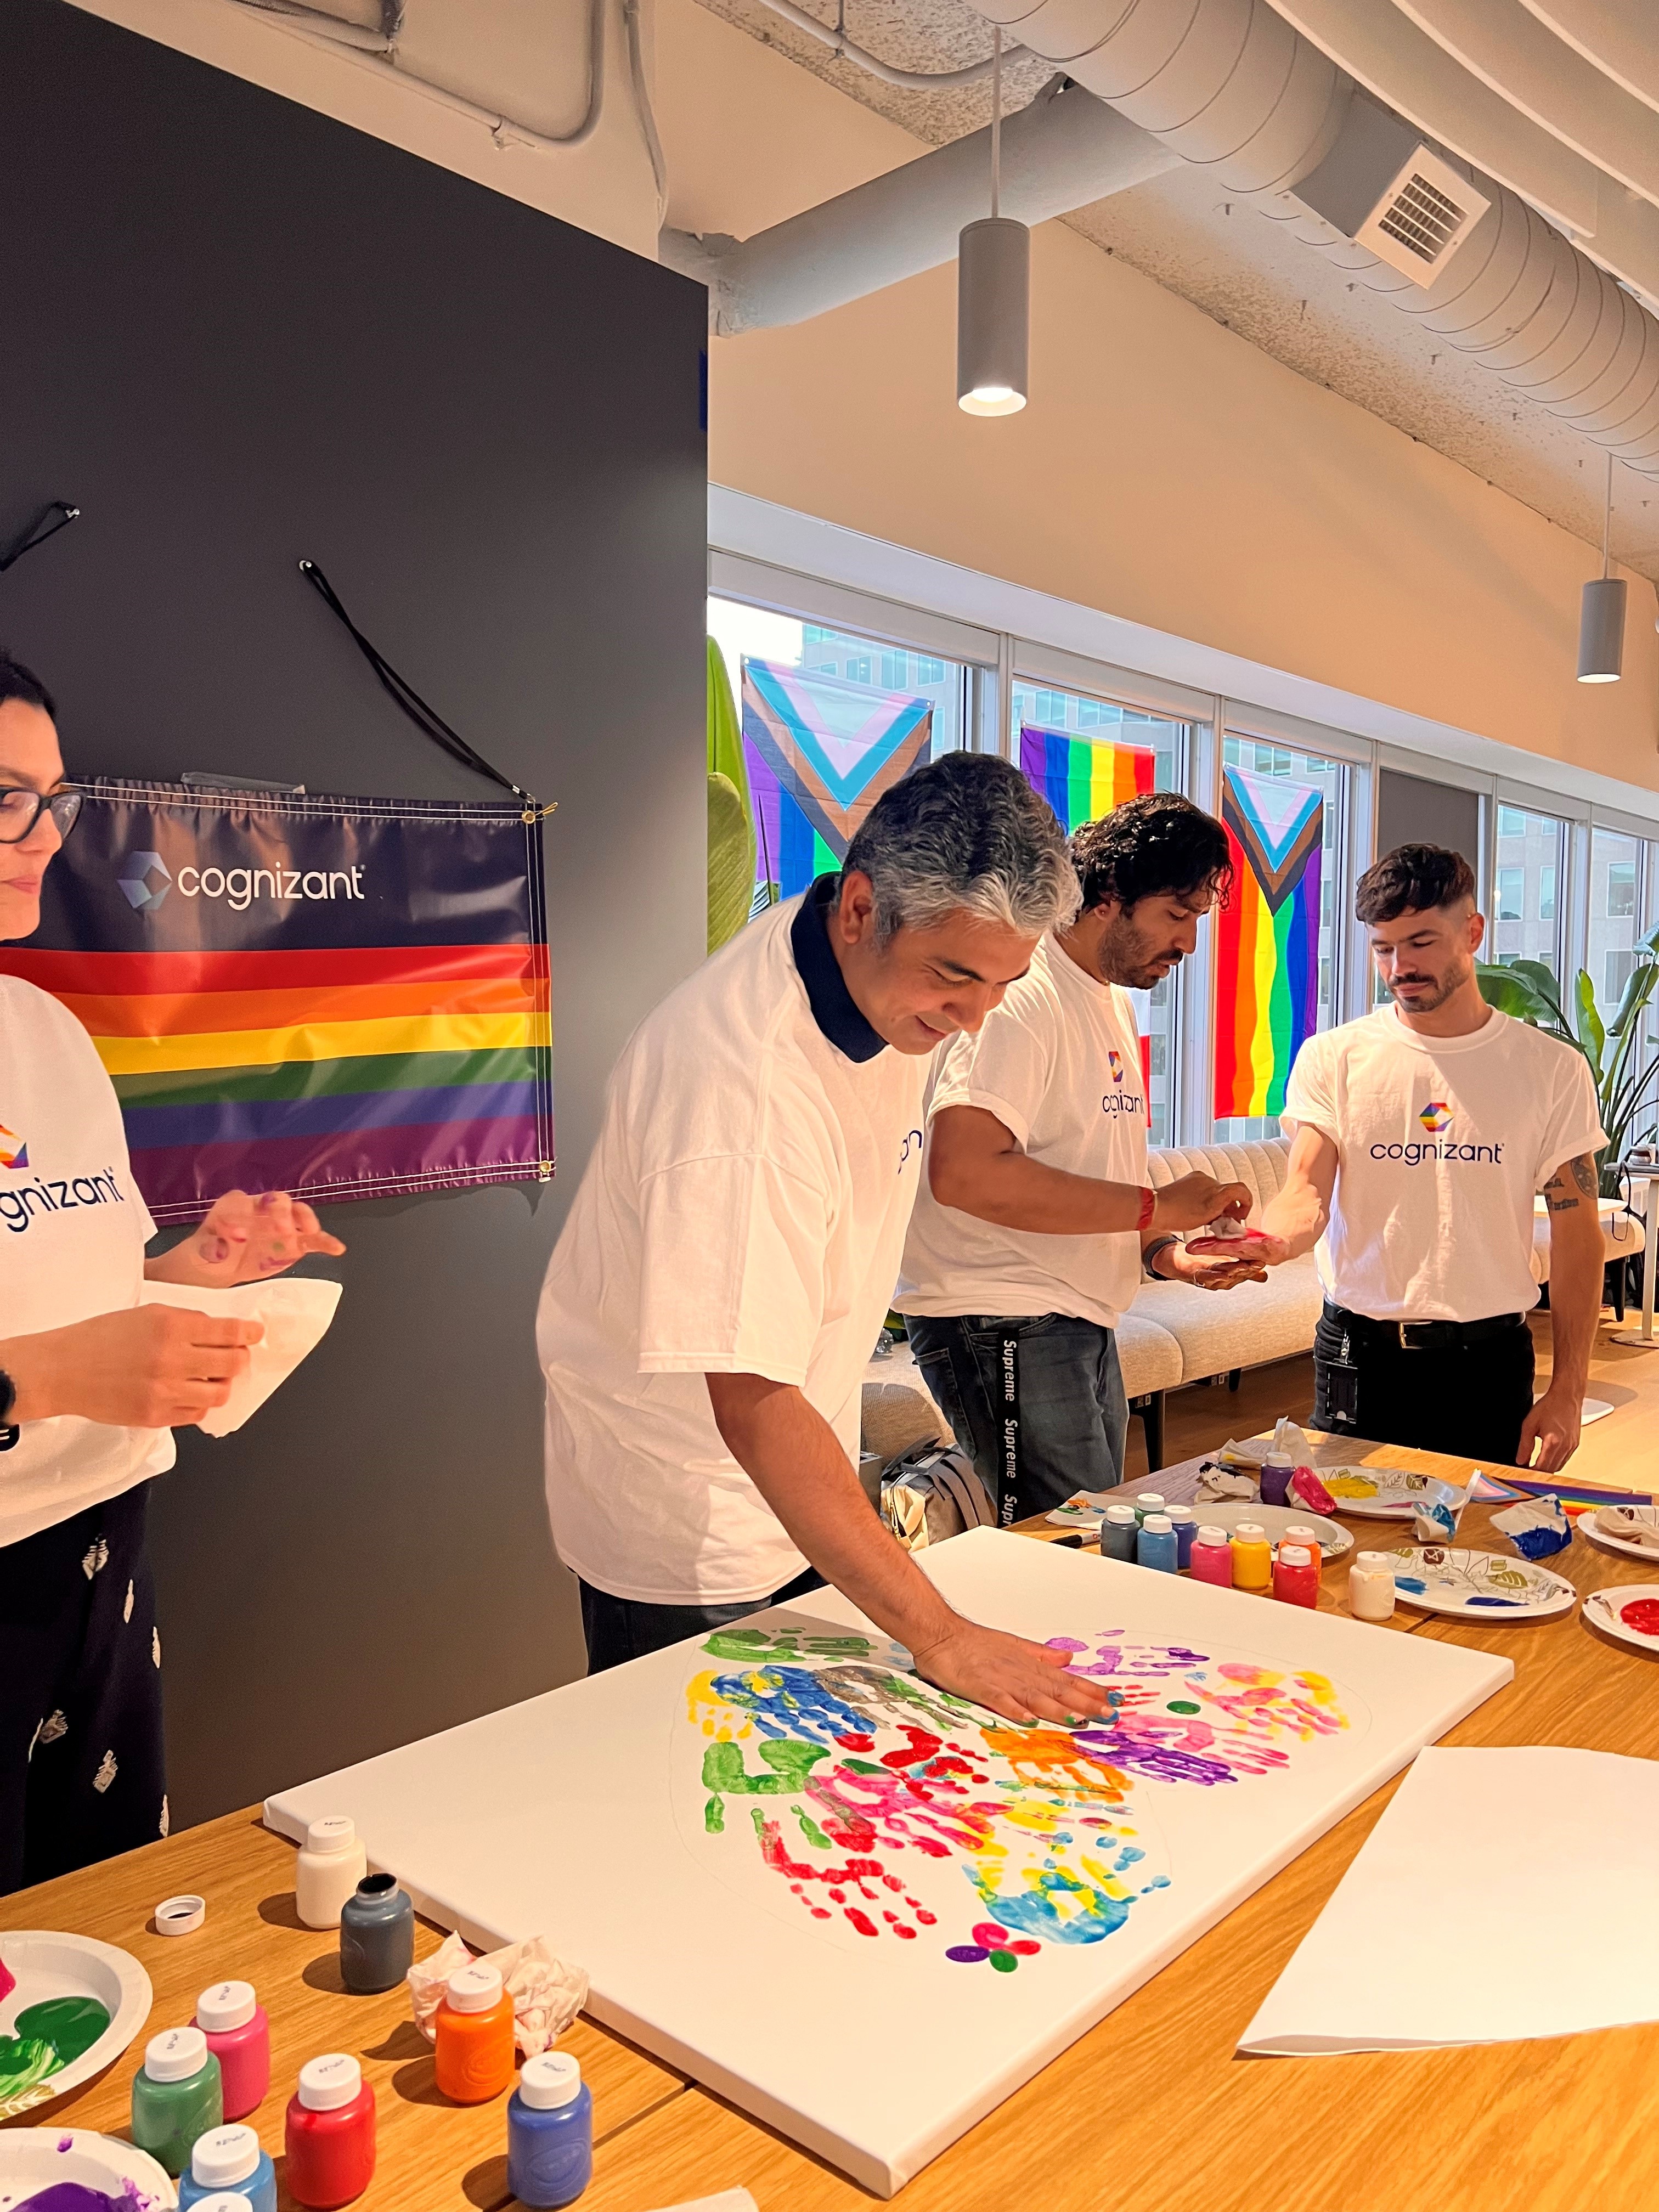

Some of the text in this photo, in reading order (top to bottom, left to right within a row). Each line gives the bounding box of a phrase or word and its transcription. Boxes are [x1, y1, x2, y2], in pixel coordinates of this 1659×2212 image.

[178, 861, 364, 910] cognizant
[1370, 1139, 1502, 1166] cognizant
[1002, 1340, 1017, 1401] Supreme
[1003, 1418, 1018, 1478] Supreme
